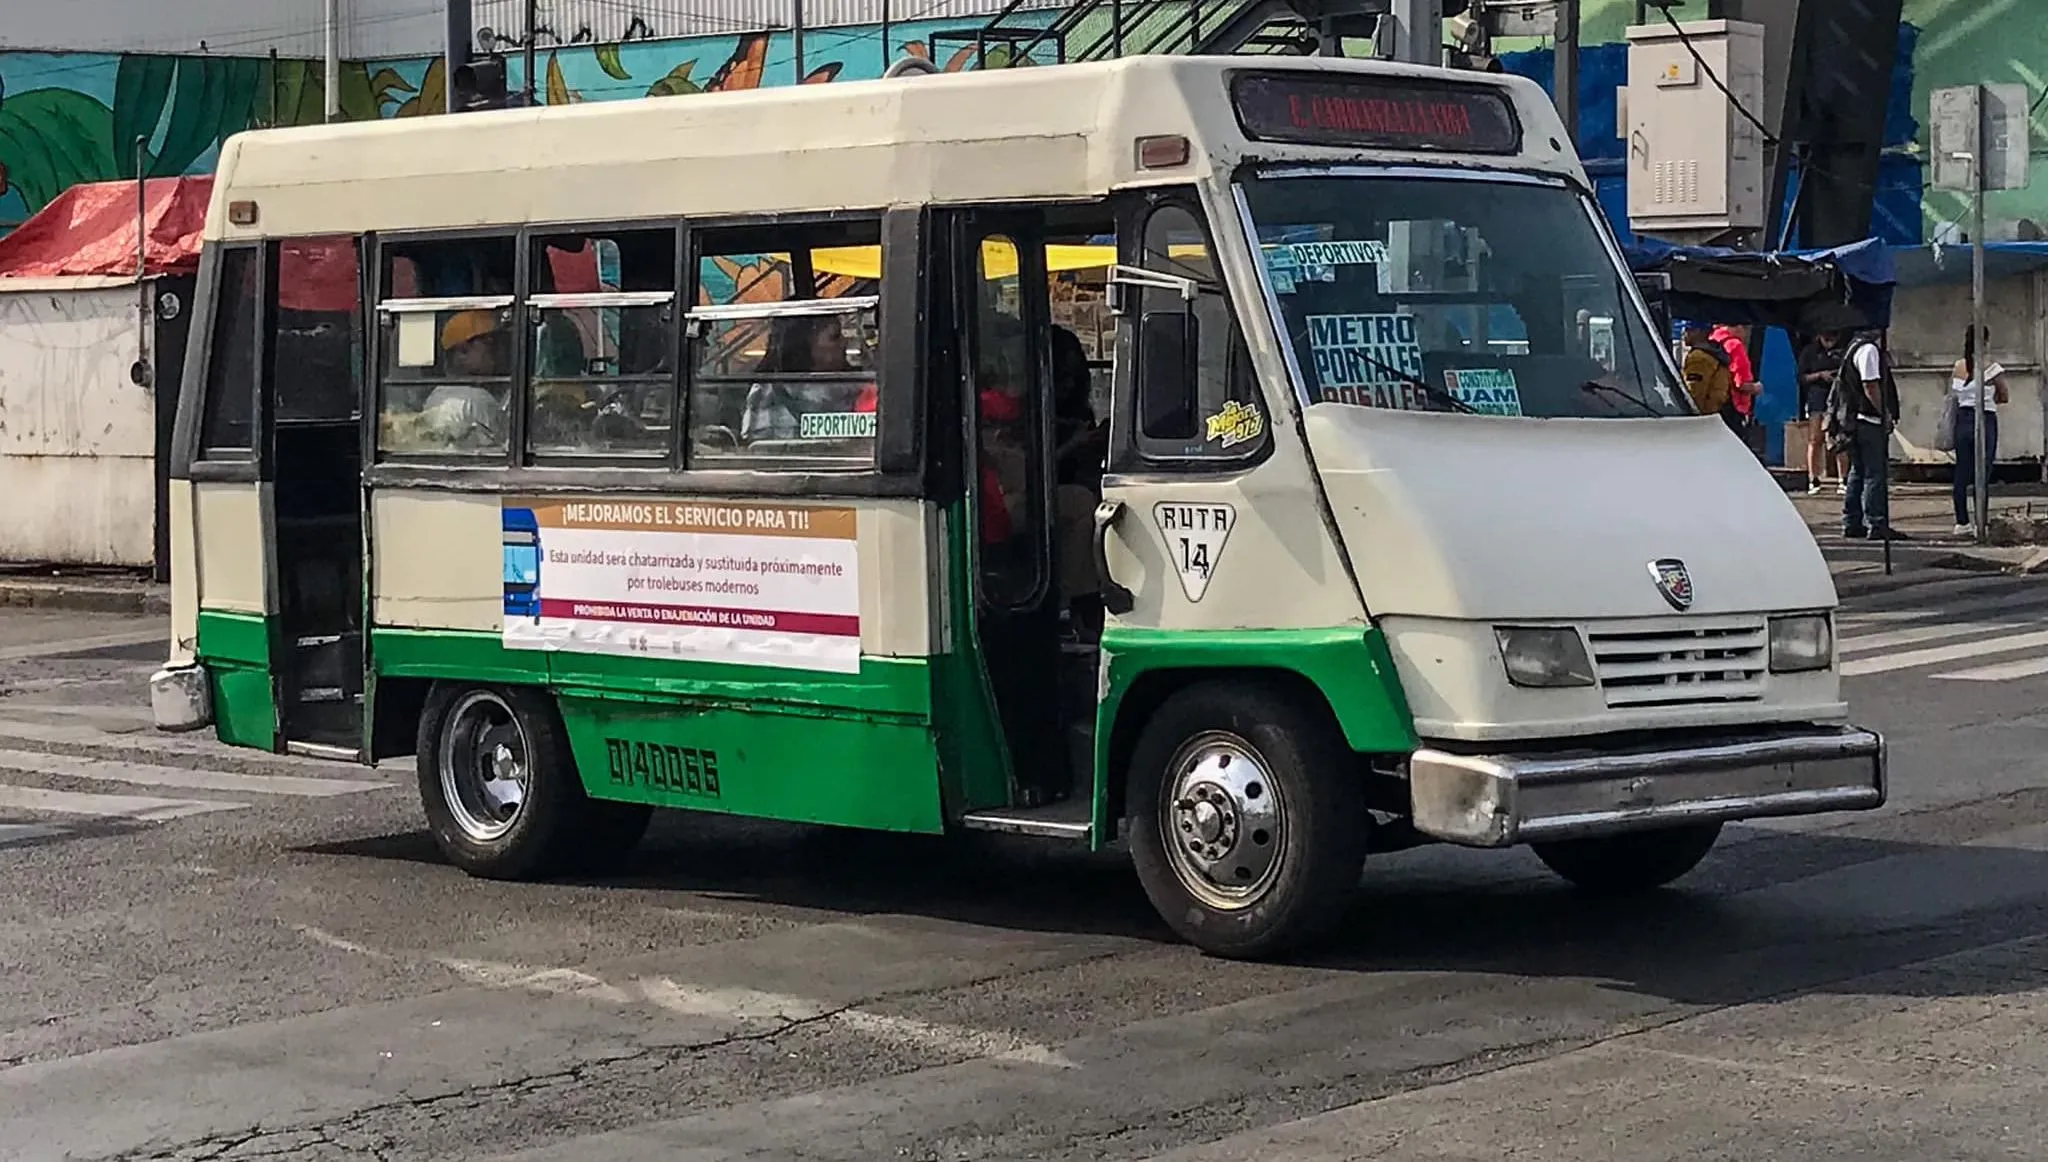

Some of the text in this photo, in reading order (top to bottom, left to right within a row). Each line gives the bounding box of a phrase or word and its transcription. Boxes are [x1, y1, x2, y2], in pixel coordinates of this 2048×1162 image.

[1311, 316, 1416, 346] METRO
[1313, 345, 1421, 384] PORTALES
[1451, 388, 1516, 403] UAM
[562, 503, 809, 530] ¡MEJORAMOS EL SERVICIO PARA TI!
[1162, 507, 1227, 531] RUTA
[550, 549, 569, 563] Esta
[571, 550, 604, 565] unidad
[628, 553, 695, 569] chatarrizada
[697, 558, 704, 573] y
[705, 556, 759, 572] sustituida
[760, 557, 843, 576] próximamente
[1180, 537, 1210, 579] 14
[627, 576, 760, 595] por trolebuses modernos
[616, 606, 627, 618] LA
[653, 608, 660, 620] O
[719, 611, 730, 624] DE
[731, 612, 742, 625] LA
[604, 737, 721, 798] 0140066
